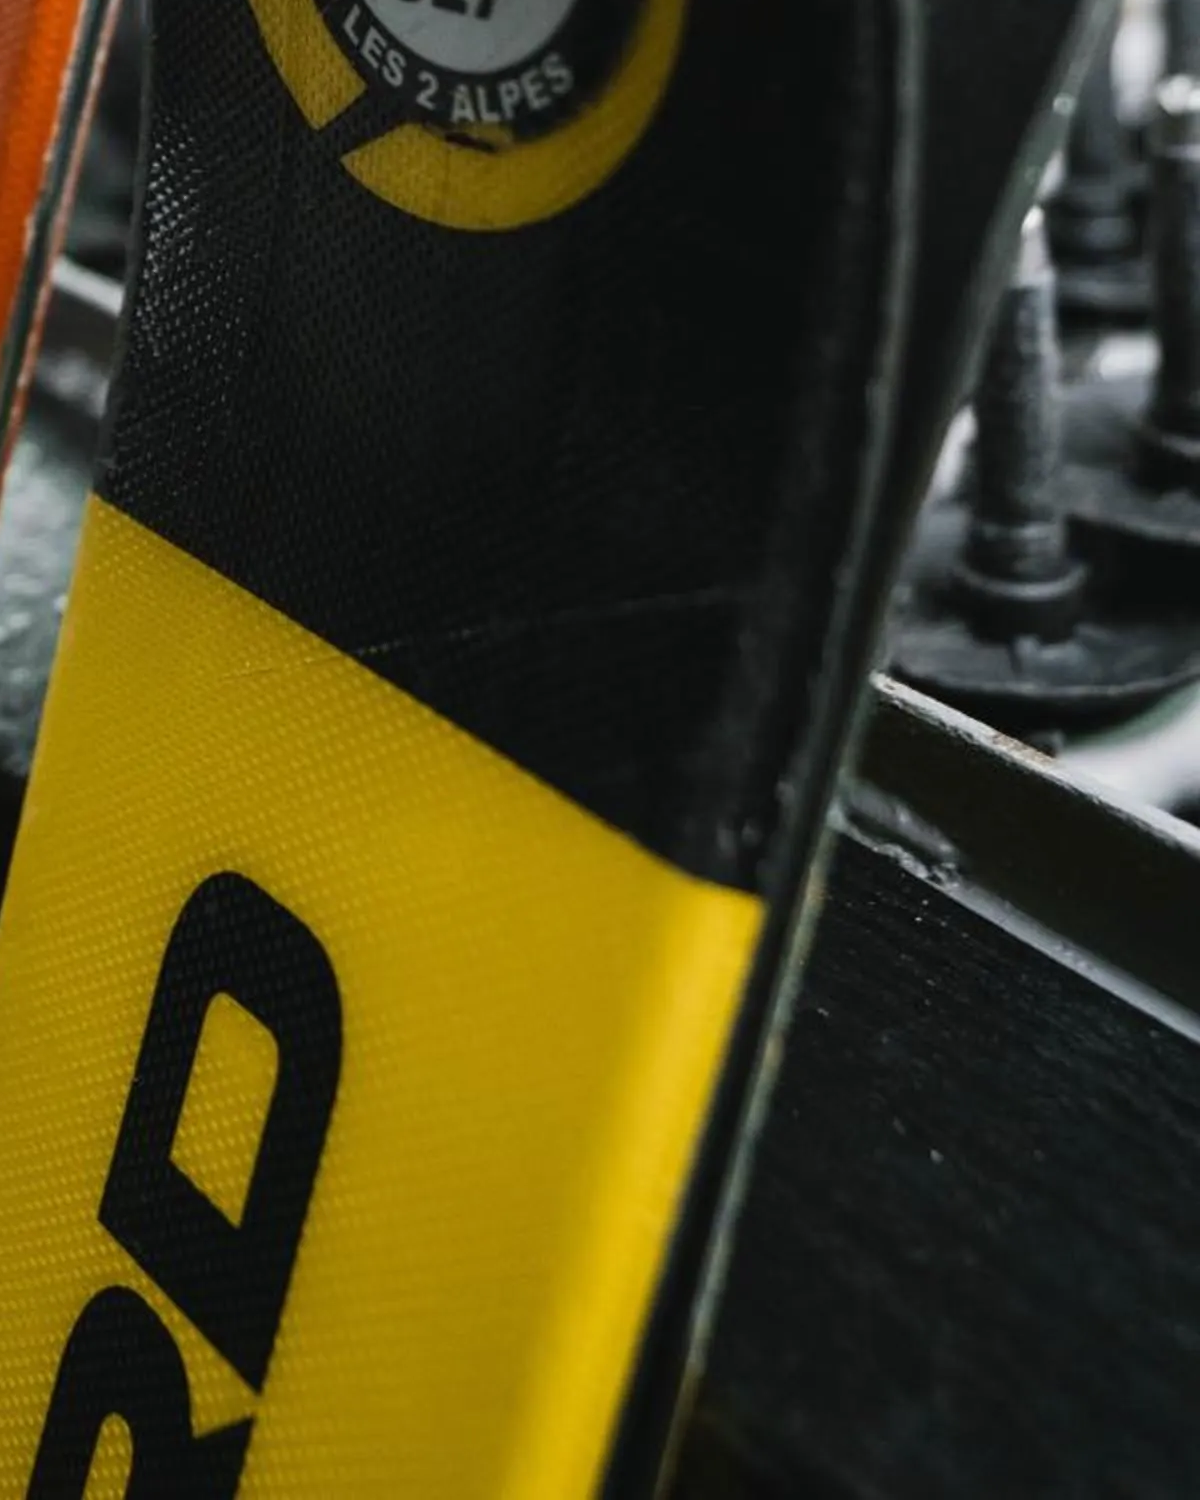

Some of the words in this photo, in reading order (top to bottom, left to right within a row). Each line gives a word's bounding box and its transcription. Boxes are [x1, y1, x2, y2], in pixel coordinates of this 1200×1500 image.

[341, 3, 404, 88] LES
[415, 72, 441, 110] 2
[450, 50, 575, 125] ALPES
